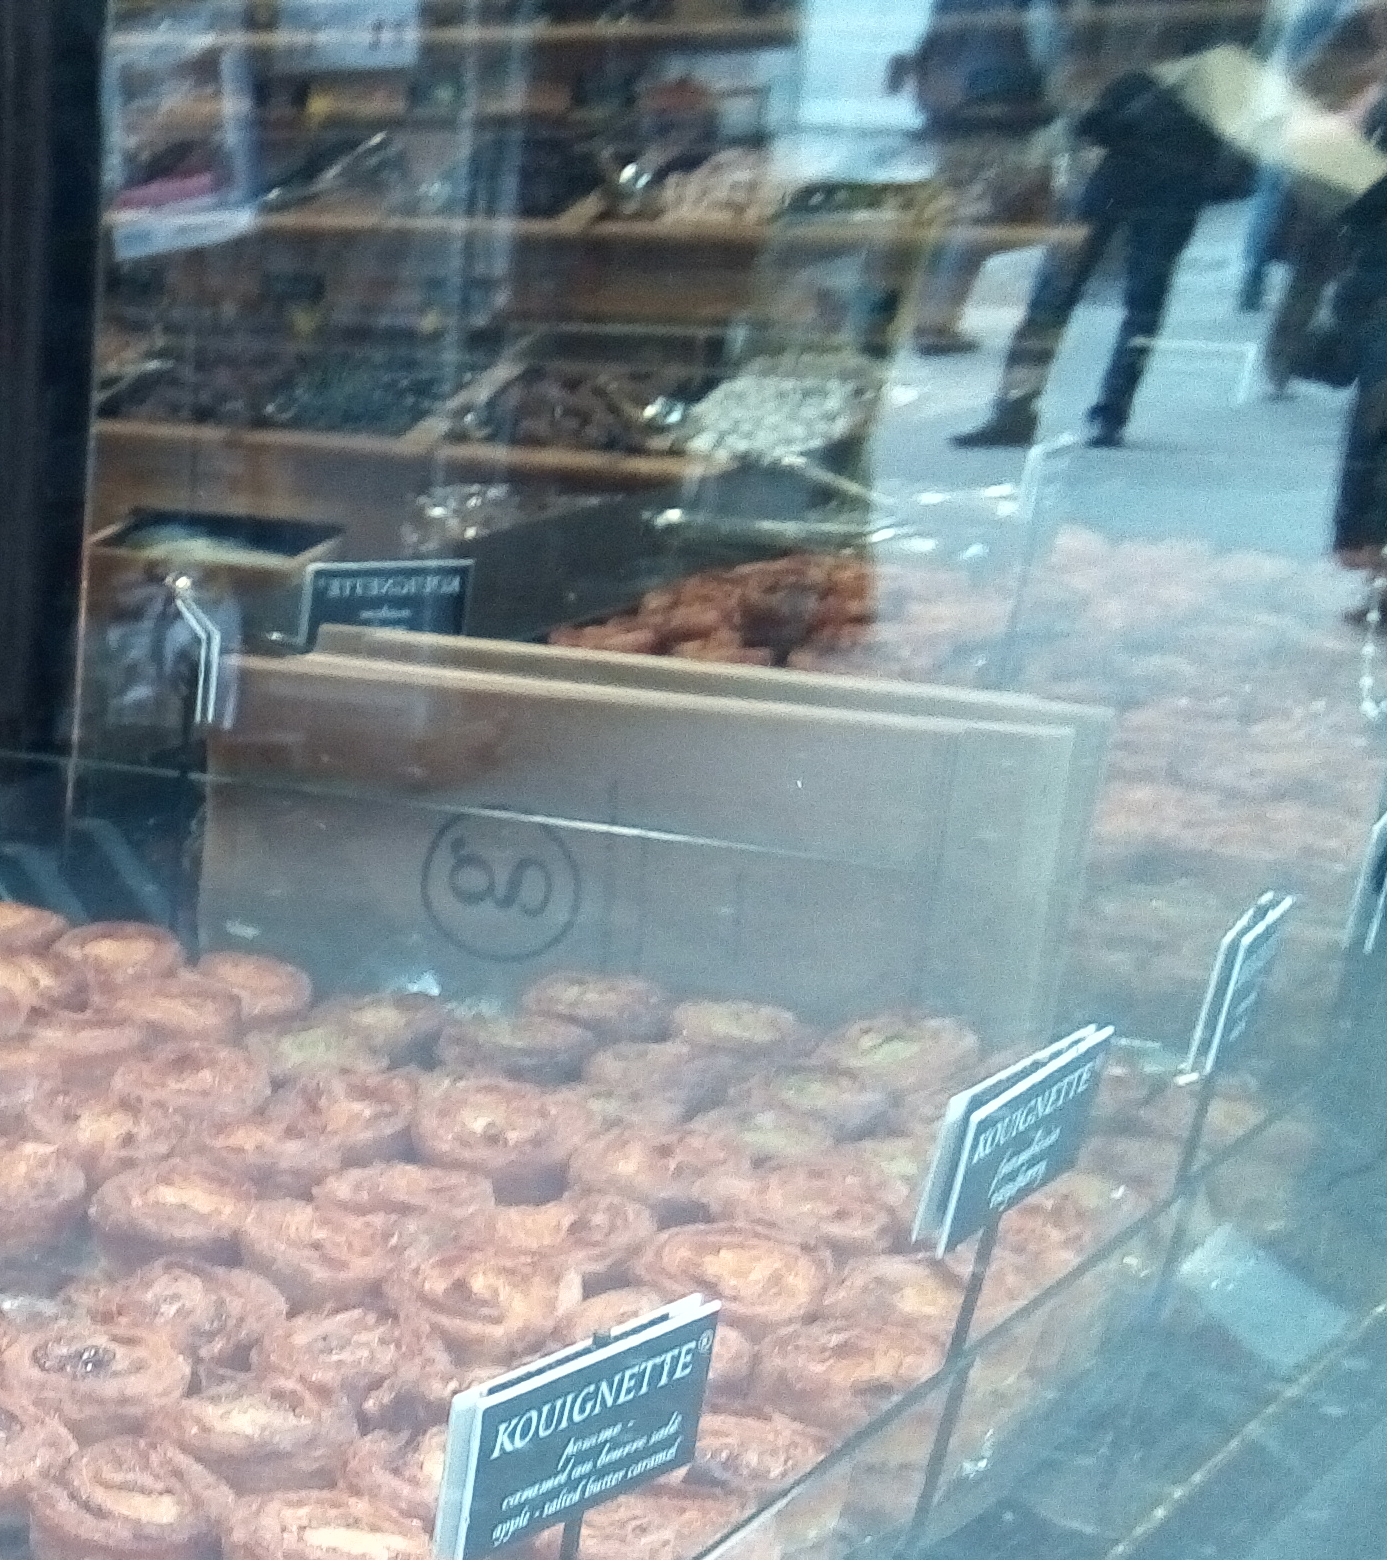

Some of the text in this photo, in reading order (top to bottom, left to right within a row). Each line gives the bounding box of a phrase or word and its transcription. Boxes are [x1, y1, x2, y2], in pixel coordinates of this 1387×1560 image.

[501, 1456, 576, 1511] caramel
[571, 1459, 594, 1481] au
[596, 1434, 648, 1469] beurre
[557, 1422, 623, 1471] pomme
[492, 1505, 531, 1548] apple
[542, 1478, 587, 1519] salted
[584, 1467, 627, 1499] butter
[627, 1435, 684, 1479] caramel
